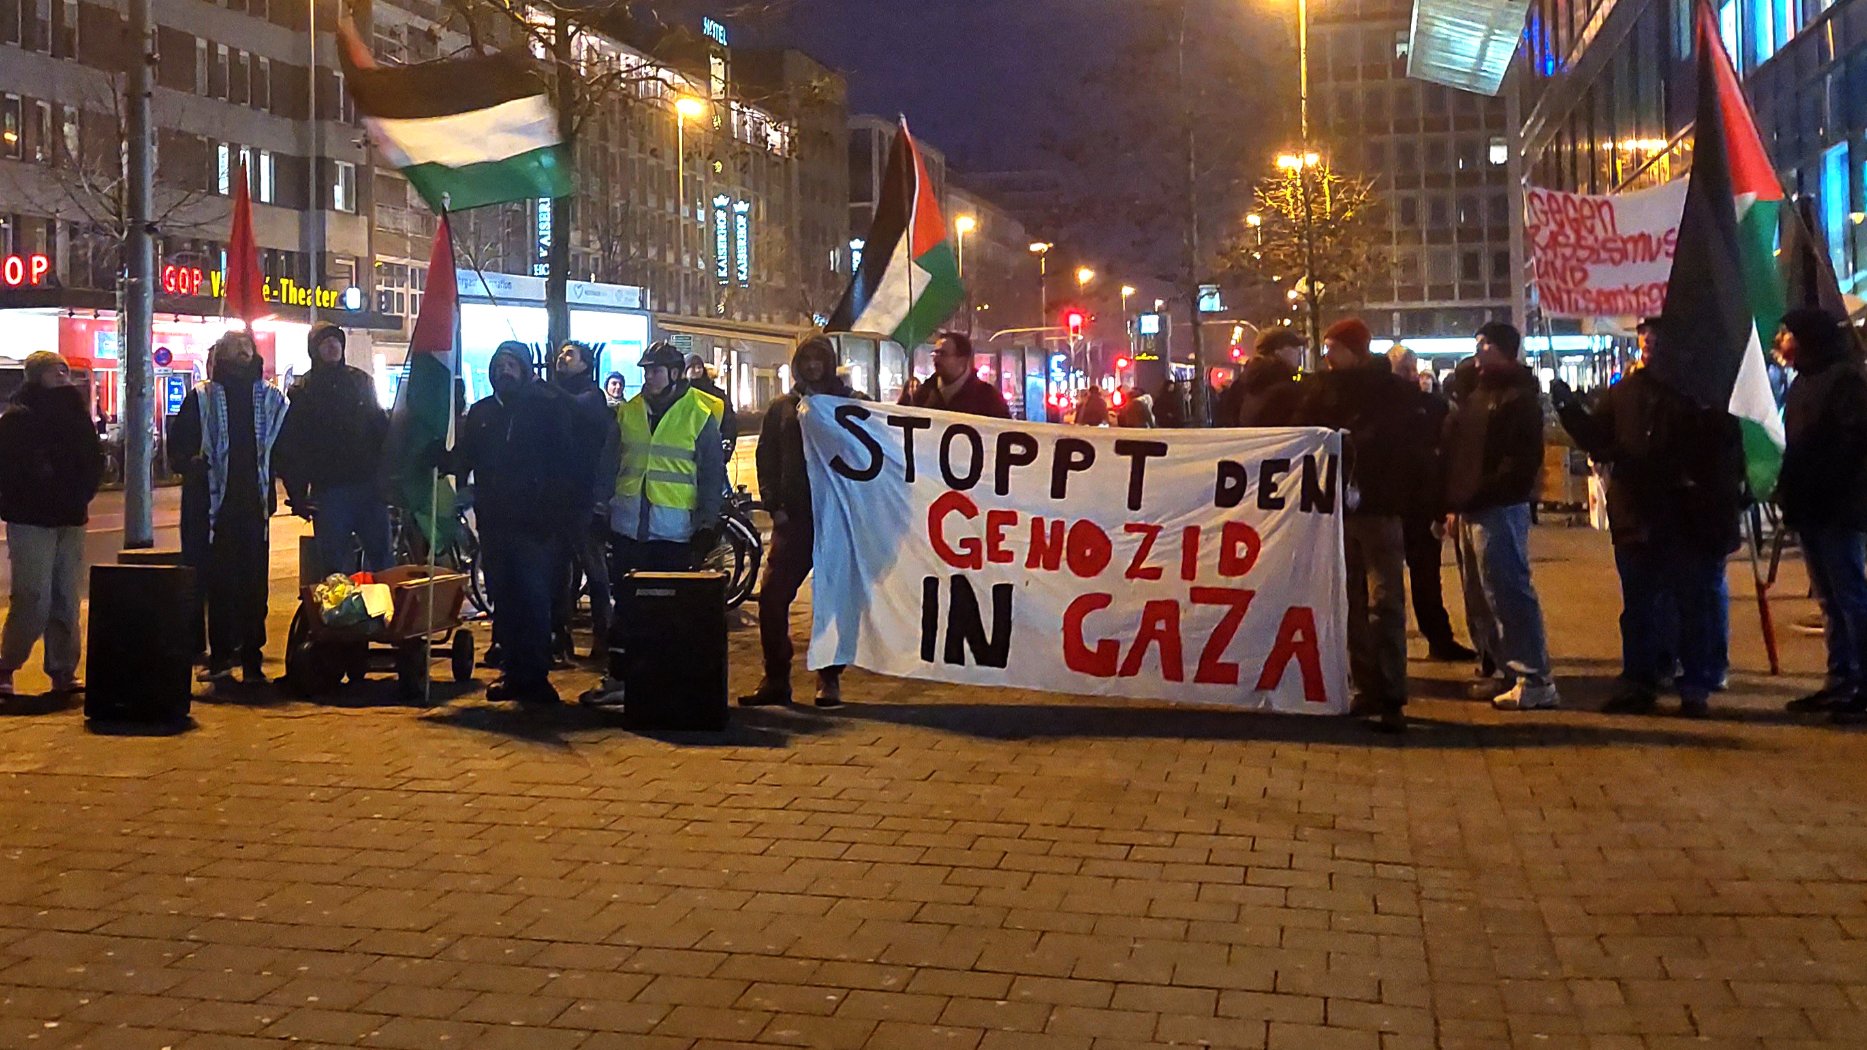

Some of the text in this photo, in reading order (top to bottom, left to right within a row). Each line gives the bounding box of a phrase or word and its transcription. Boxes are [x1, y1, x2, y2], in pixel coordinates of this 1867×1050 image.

[164, 265, 202, 295] GOP
[716, 209, 728, 277] KAISERHOF
[736, 214, 747, 281] KAISERHOF
[829, 404, 1337, 514] STOPPT DEN
[927, 490, 1262, 581] GENOZID
[920, 574, 1328, 703] IN GAZA
